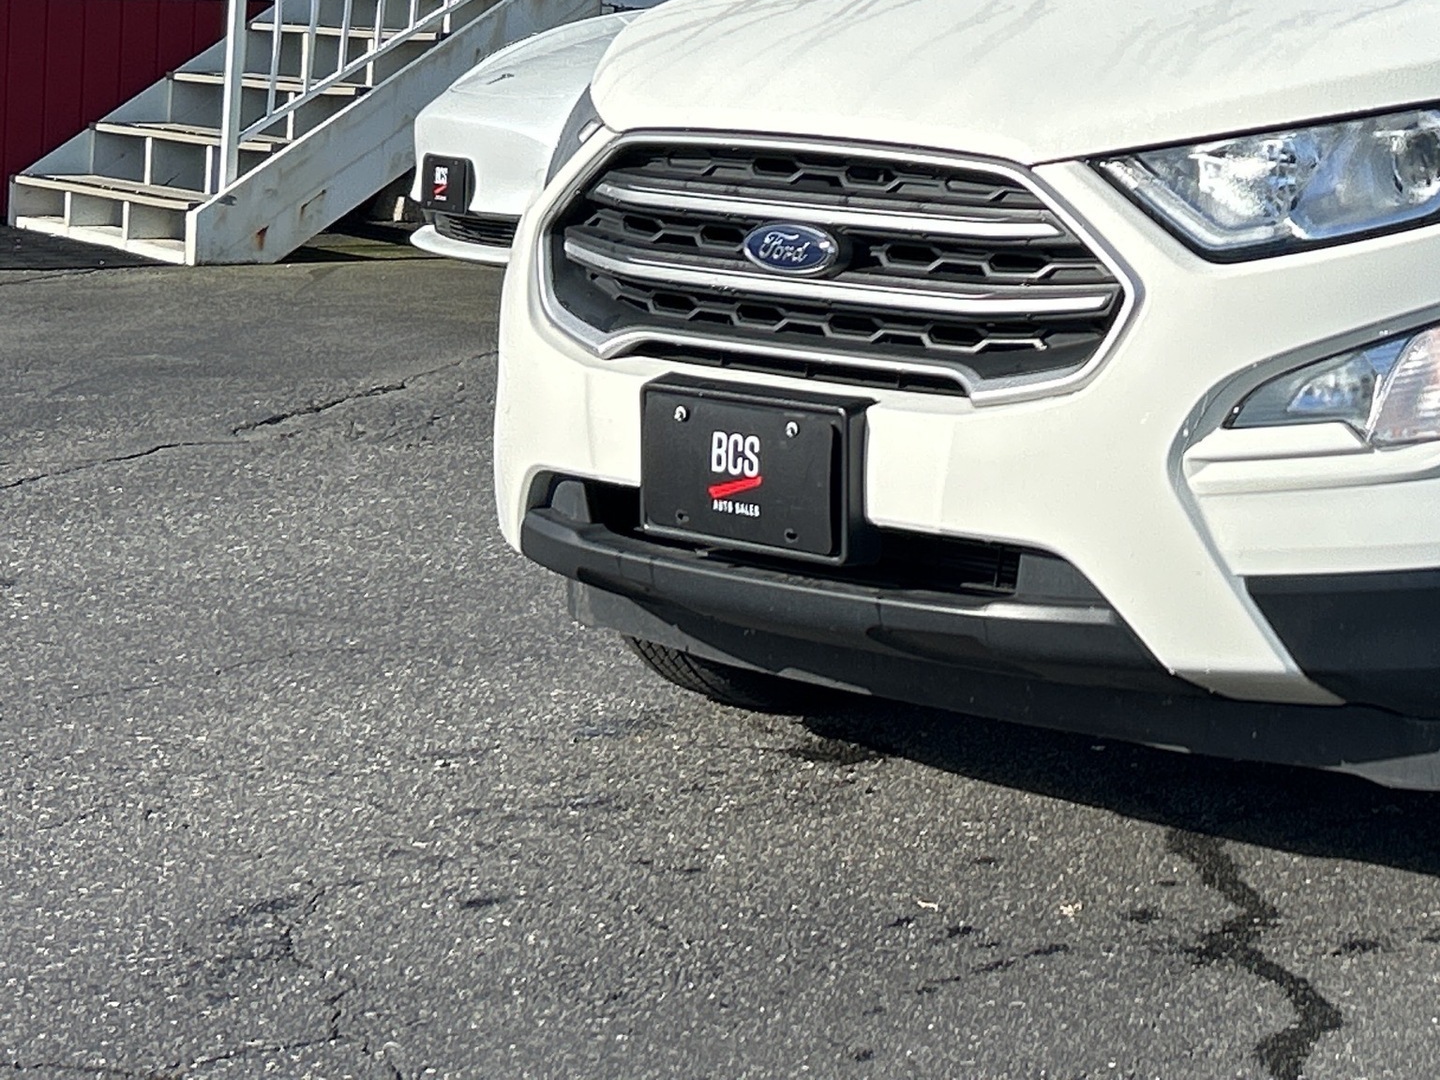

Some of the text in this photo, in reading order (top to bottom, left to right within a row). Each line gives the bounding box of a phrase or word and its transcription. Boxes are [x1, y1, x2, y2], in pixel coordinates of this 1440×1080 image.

[758, 231, 811, 262] Ford
[711, 431, 760, 478] BCS
[713, 499, 760, 517] AUTO SALES
